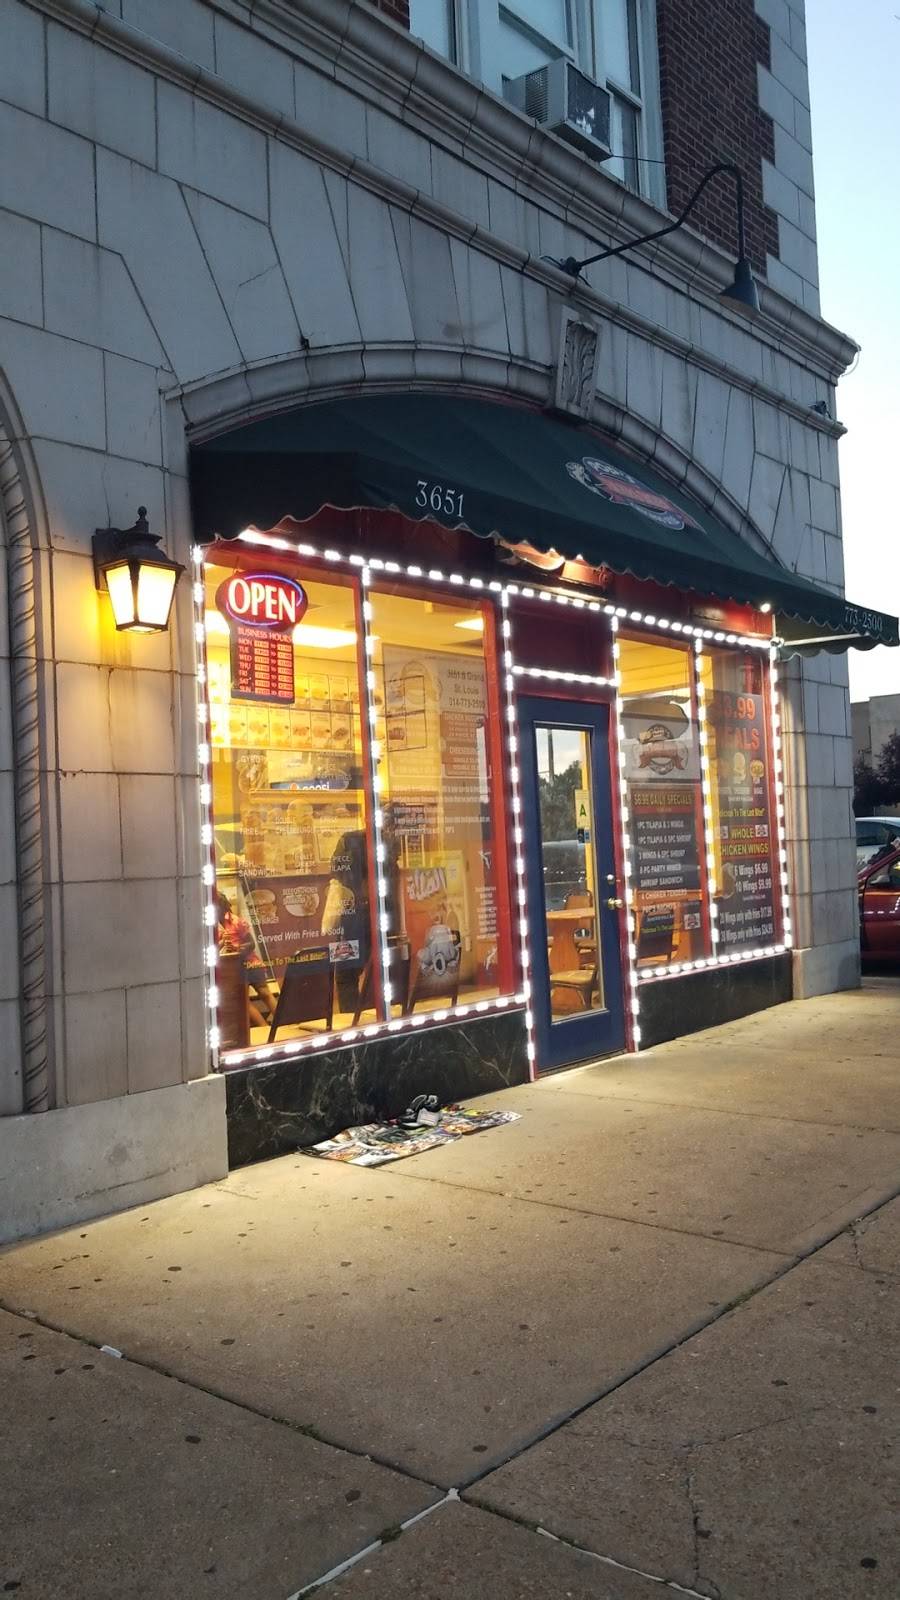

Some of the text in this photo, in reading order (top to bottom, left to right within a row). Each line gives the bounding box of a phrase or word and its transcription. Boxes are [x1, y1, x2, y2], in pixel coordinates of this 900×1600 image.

[415, 480, 465, 518] 3651
[228, 578, 296, 623] OPEN
[844, 607, 883, 633] 773-2500
[238, 627, 292, 643] BUSINESS HOURS
[238, 638, 252, 646] MON
[239, 653, 252, 662] WED
[239, 669, 248, 677] FRI
[239, 677, 249, 685] SAT
[579, 804, 587, 817] A
[731, 828, 754, 840] WHOLE
[746, 842, 769, 855] WINGS
[650, 863, 667, 873] PARTY
[738, 864, 754, 878] Wings
[659, 876, 684, 886] SANDWICH
[742, 880, 758, 894] Wings
[258, 933, 283, 943] Served
[284, 931, 301, 941] With
[302, 929, 320, 938] Fries
[328, 926, 345, 936] Soda
[276, 957, 284, 966] To
